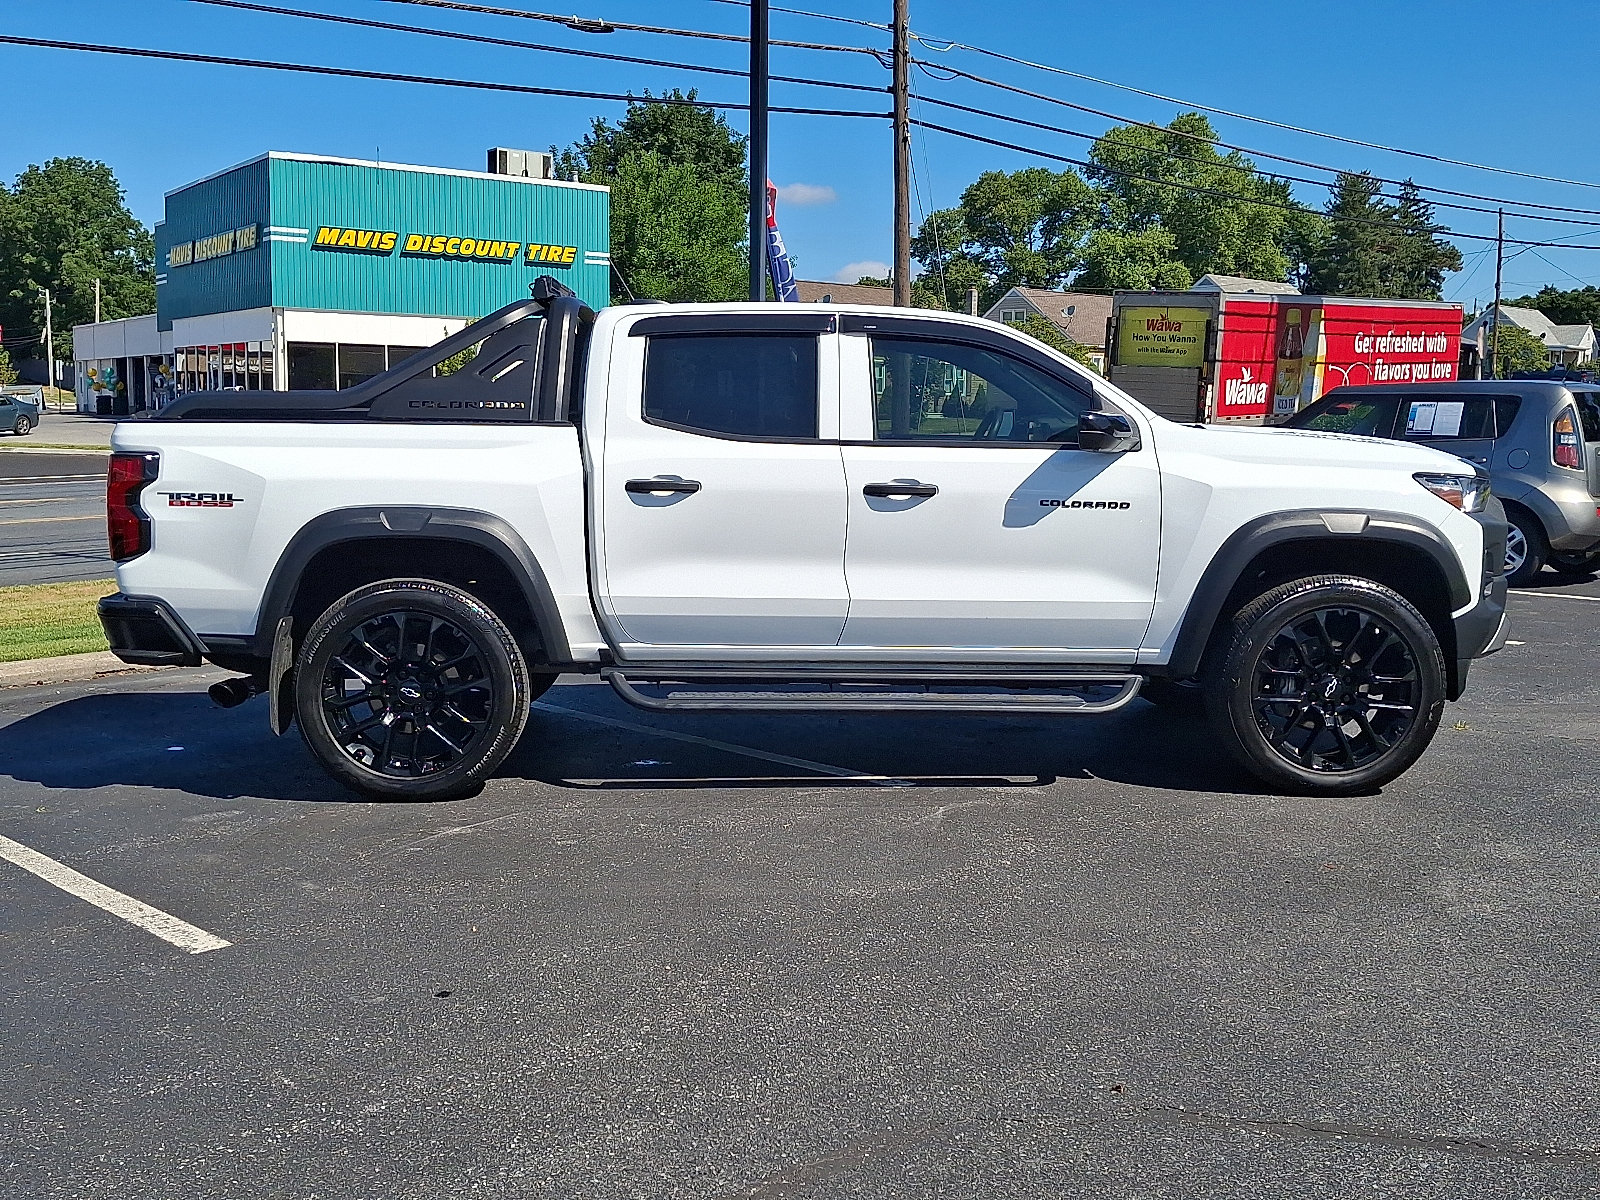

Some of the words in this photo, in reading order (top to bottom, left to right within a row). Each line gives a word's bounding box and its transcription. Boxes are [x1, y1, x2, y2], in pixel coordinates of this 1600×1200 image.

[169, 241, 192, 265] MAVIS
[194, 230, 234, 260] DISCOUNT
[236, 224, 256, 251] TIRE
[316, 226, 397, 250] MAVIS
[405, 234, 521, 259] DISCOUNT
[529, 243, 577, 264] TIRE
[1146, 318, 1182, 332] Wawa
[1132, 332, 1150, 342] How
[1152, 333, 1167, 342] You
[1168, 334, 1197, 344] Wanna
[1354, 331, 1374, 354] Get
[1375, 330, 1425, 353] refreshed
[1426, 331, 1447, 353] with
[1373, 358, 1411, 381] flavors
[1411, 363, 1431, 384] you
[1431, 357, 1452, 379] love
[1225, 378, 1269, 406] Wawa
[408, 400, 526, 410] COLORADO
[157, 492, 244, 502] TRAIL
[168, 500, 234, 508] BOSS
[1039, 499, 1131, 510] COLORADO
